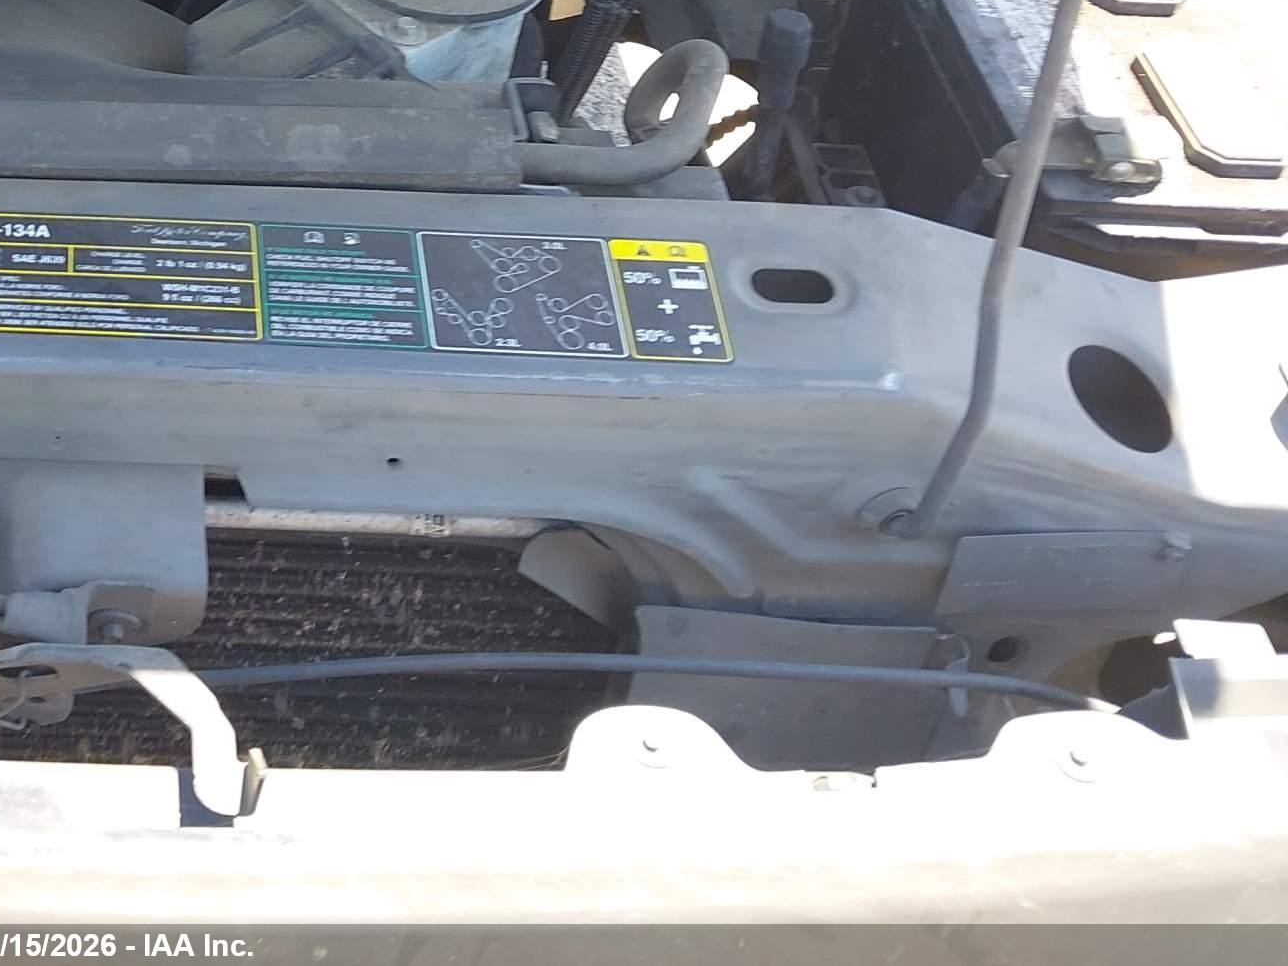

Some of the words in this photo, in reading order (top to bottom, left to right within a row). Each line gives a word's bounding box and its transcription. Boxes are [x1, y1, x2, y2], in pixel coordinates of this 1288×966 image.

[11, 254, 37, 263] SAE
[623, 271, 662, 285] 50%
[634, 329, 675, 343] 50%
[494, 337, 522, 348] 2.3L
